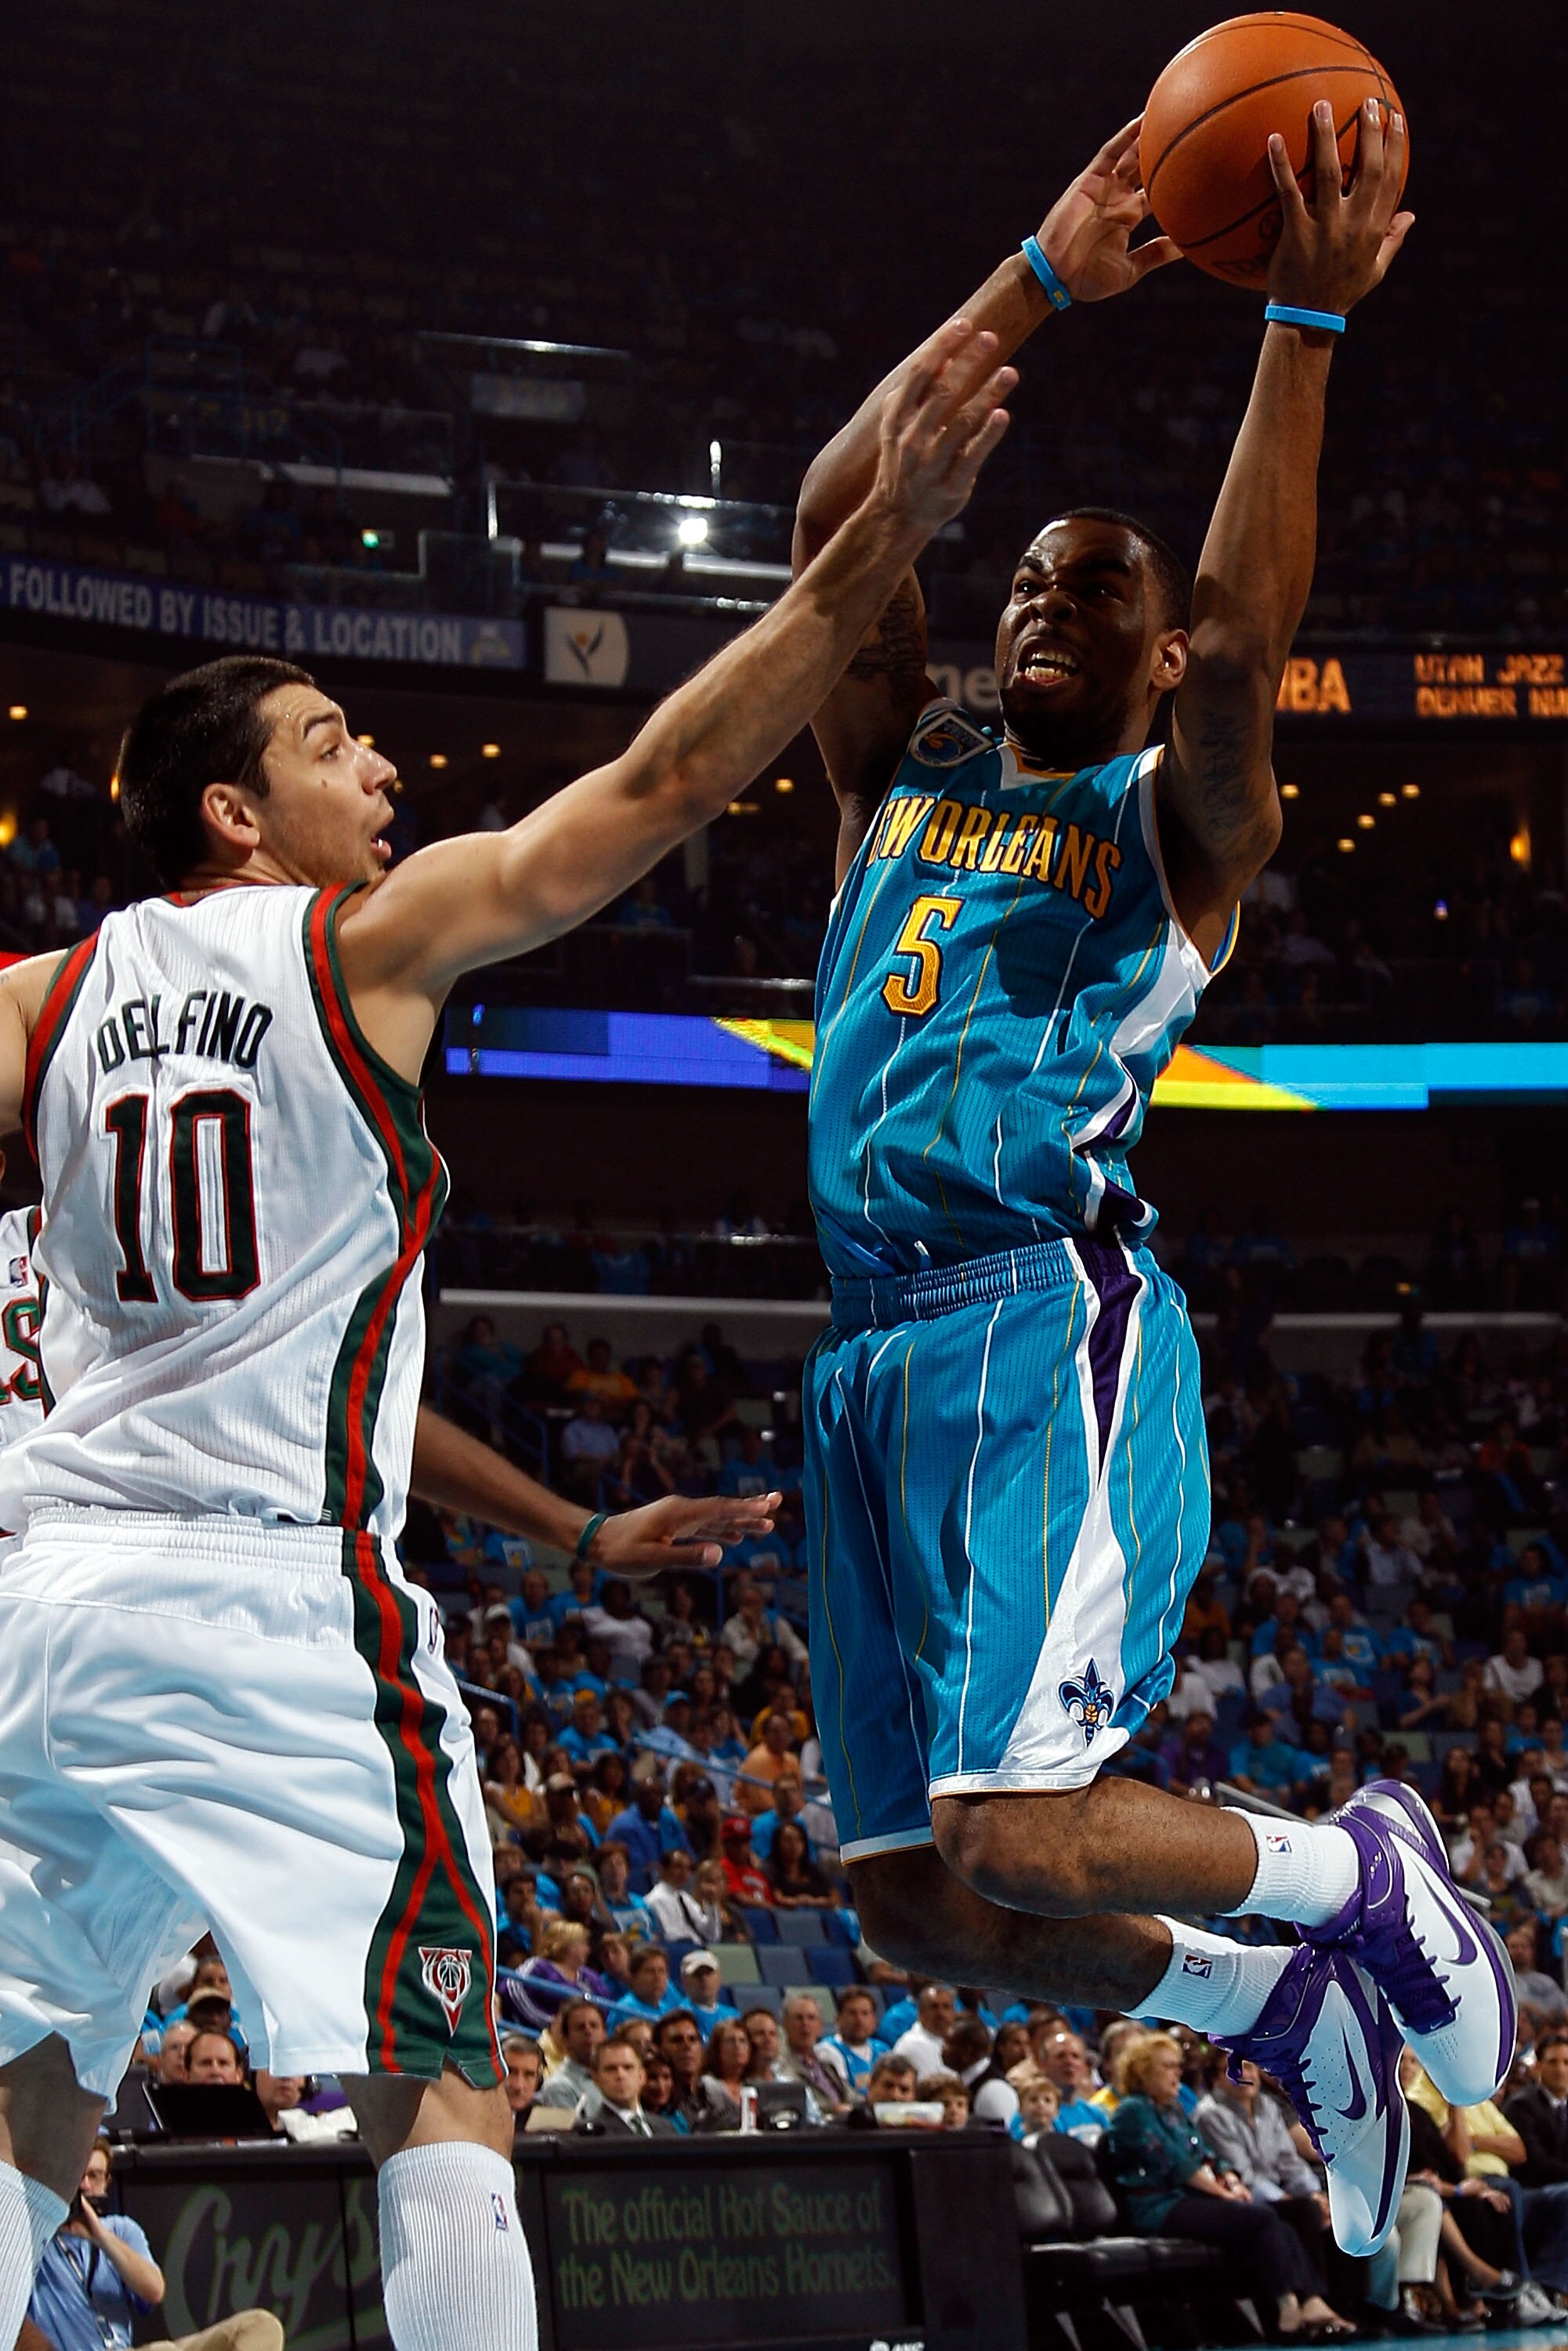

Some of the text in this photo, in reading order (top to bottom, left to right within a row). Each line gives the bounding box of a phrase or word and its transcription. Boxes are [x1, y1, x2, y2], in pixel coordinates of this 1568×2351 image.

[9, 563, 462, 662] FOLLOWED BY ISSUE & LOCATION
[1414, 654, 1564, 684] UTAH JAZZ
[1416, 686, 1517, 717] DENVER
[919, 798, 1121, 919] ORLEANS
[882, 894, 965, 1016] 5
[96, 990, 273, 1074] DELFINO
[105, 1088, 261, 1302] 10
[562, 2179, 882, 2244] The official Hot Sauce of
[558, 2243, 900, 2308] the New Orleans Hornets.
